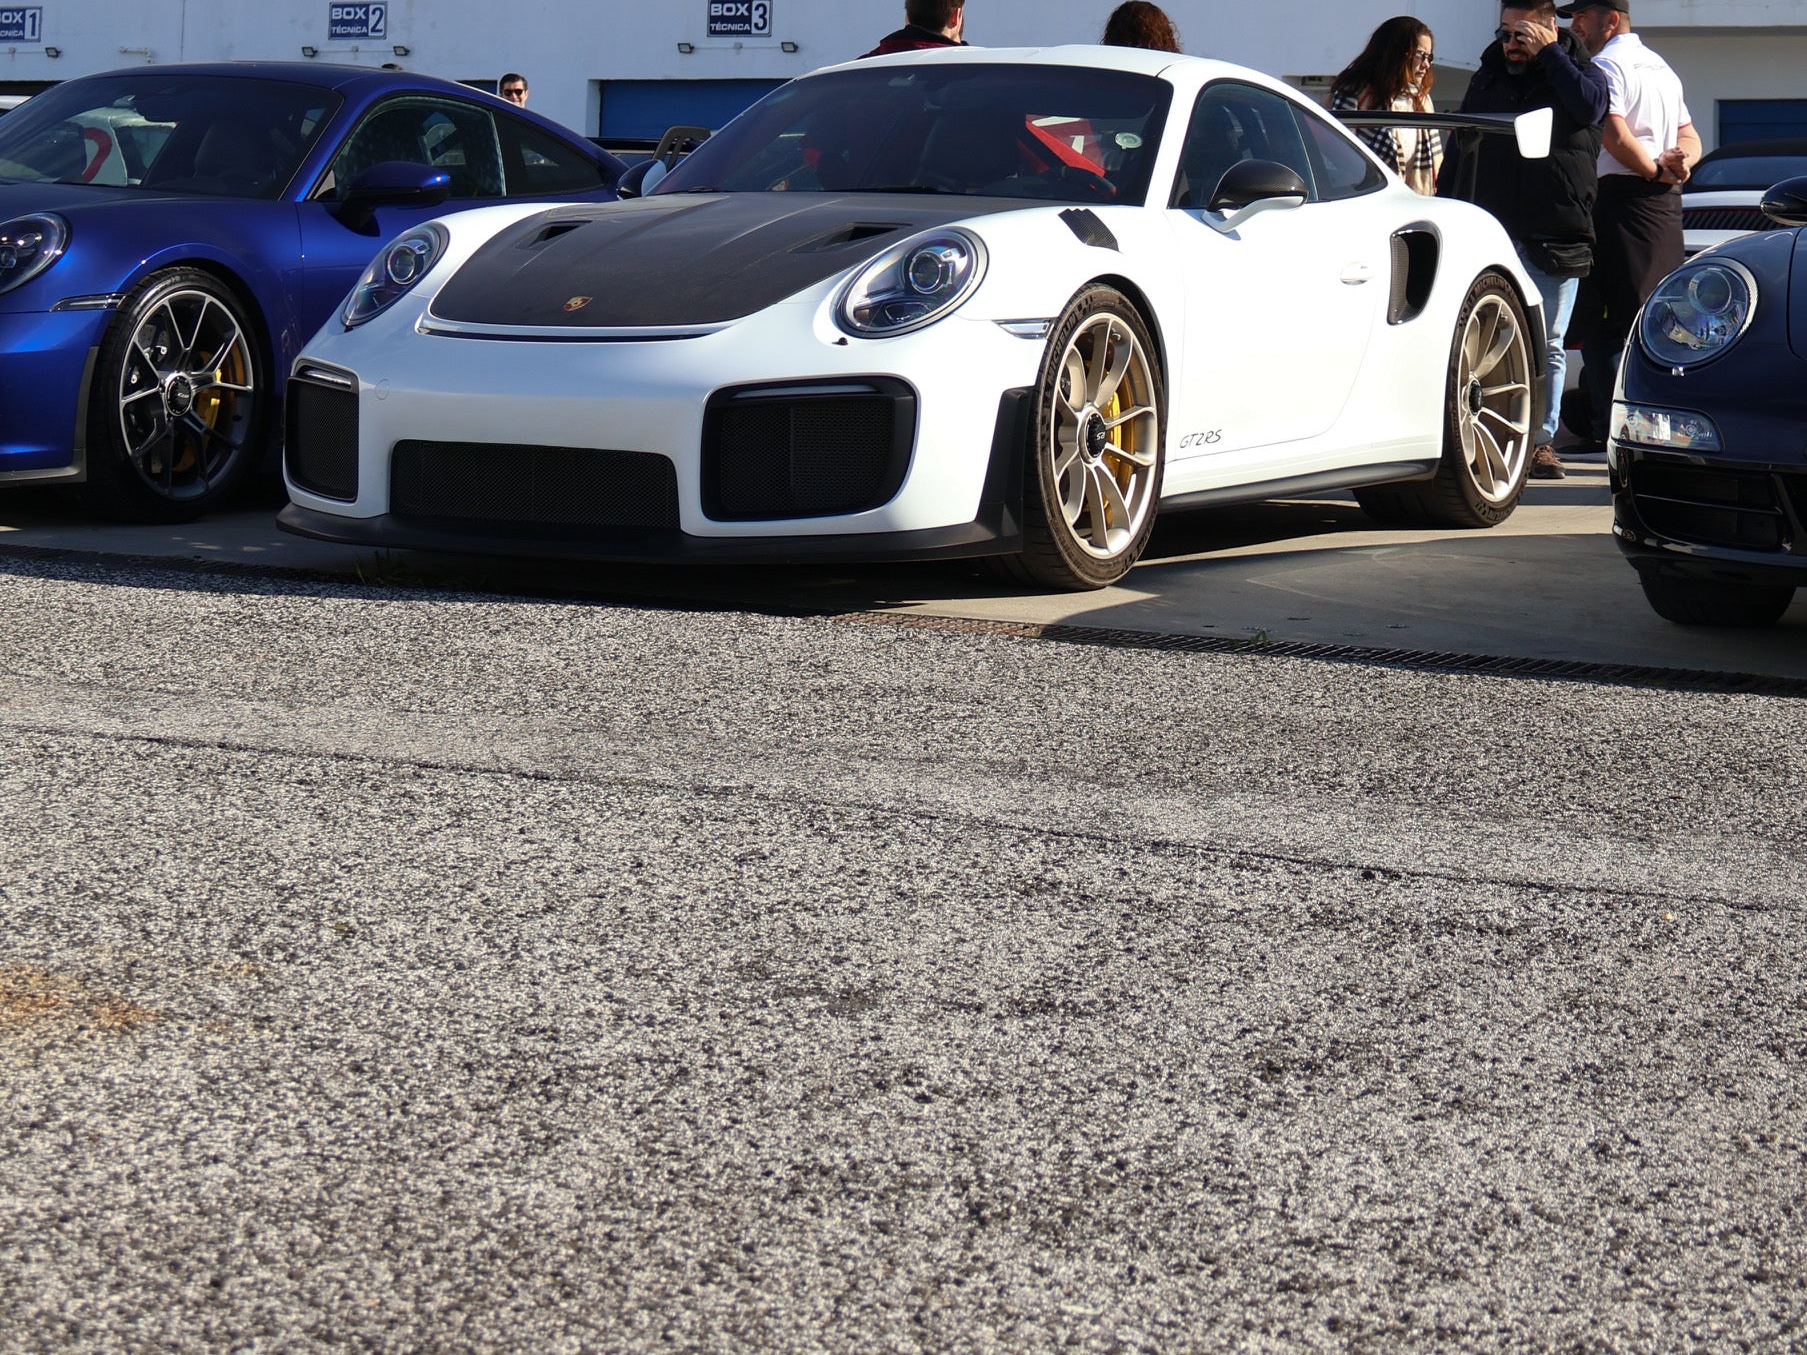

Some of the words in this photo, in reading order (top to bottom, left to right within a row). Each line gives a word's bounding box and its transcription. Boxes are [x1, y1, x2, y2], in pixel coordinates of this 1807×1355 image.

[0, 11, 23, 24] OX
[29, 11, 37, 37] 1
[331, 24, 368, 34] TÉCNICA
[332, 7, 367, 20] BOX
[370, 6, 384, 33] 2
[710, 3, 749, 16] BOX
[753, 2, 768, 31] 3
[710, 20, 750, 31] TÉCNICA
[1047, 309, 1079, 383] MICHELIN
